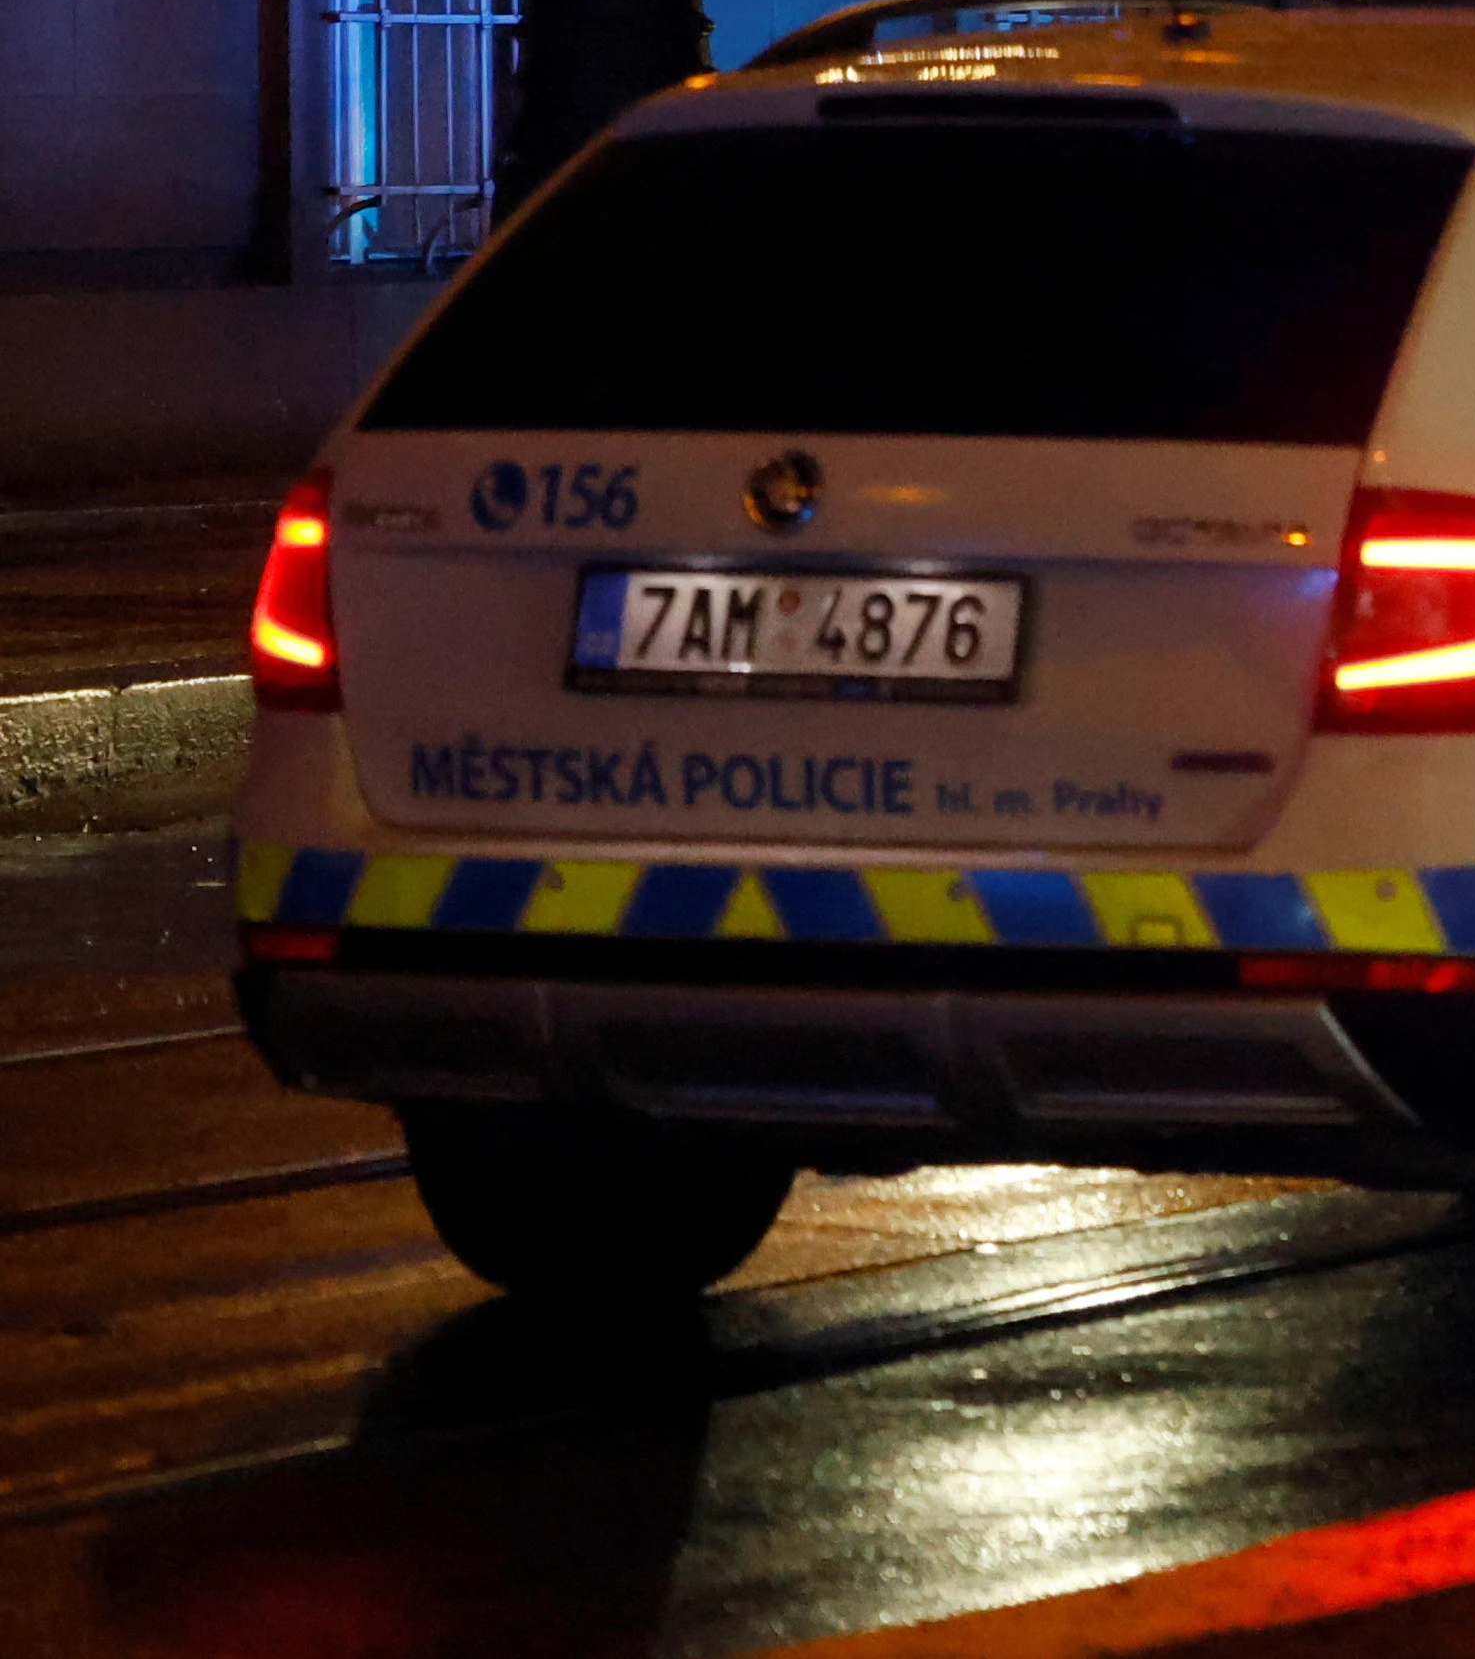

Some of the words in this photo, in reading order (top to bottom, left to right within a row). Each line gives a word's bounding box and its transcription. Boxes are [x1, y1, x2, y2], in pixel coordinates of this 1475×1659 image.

[539, 463, 640, 530] 156
[635, 585, 766, 662] 7AM
[816, 590, 987, 668] 4876
[409, 732, 667, 807] MĚSTSKÁ
[681, 751, 916, 815] POLICIE
[1052, 779, 1165, 822] Prahy
